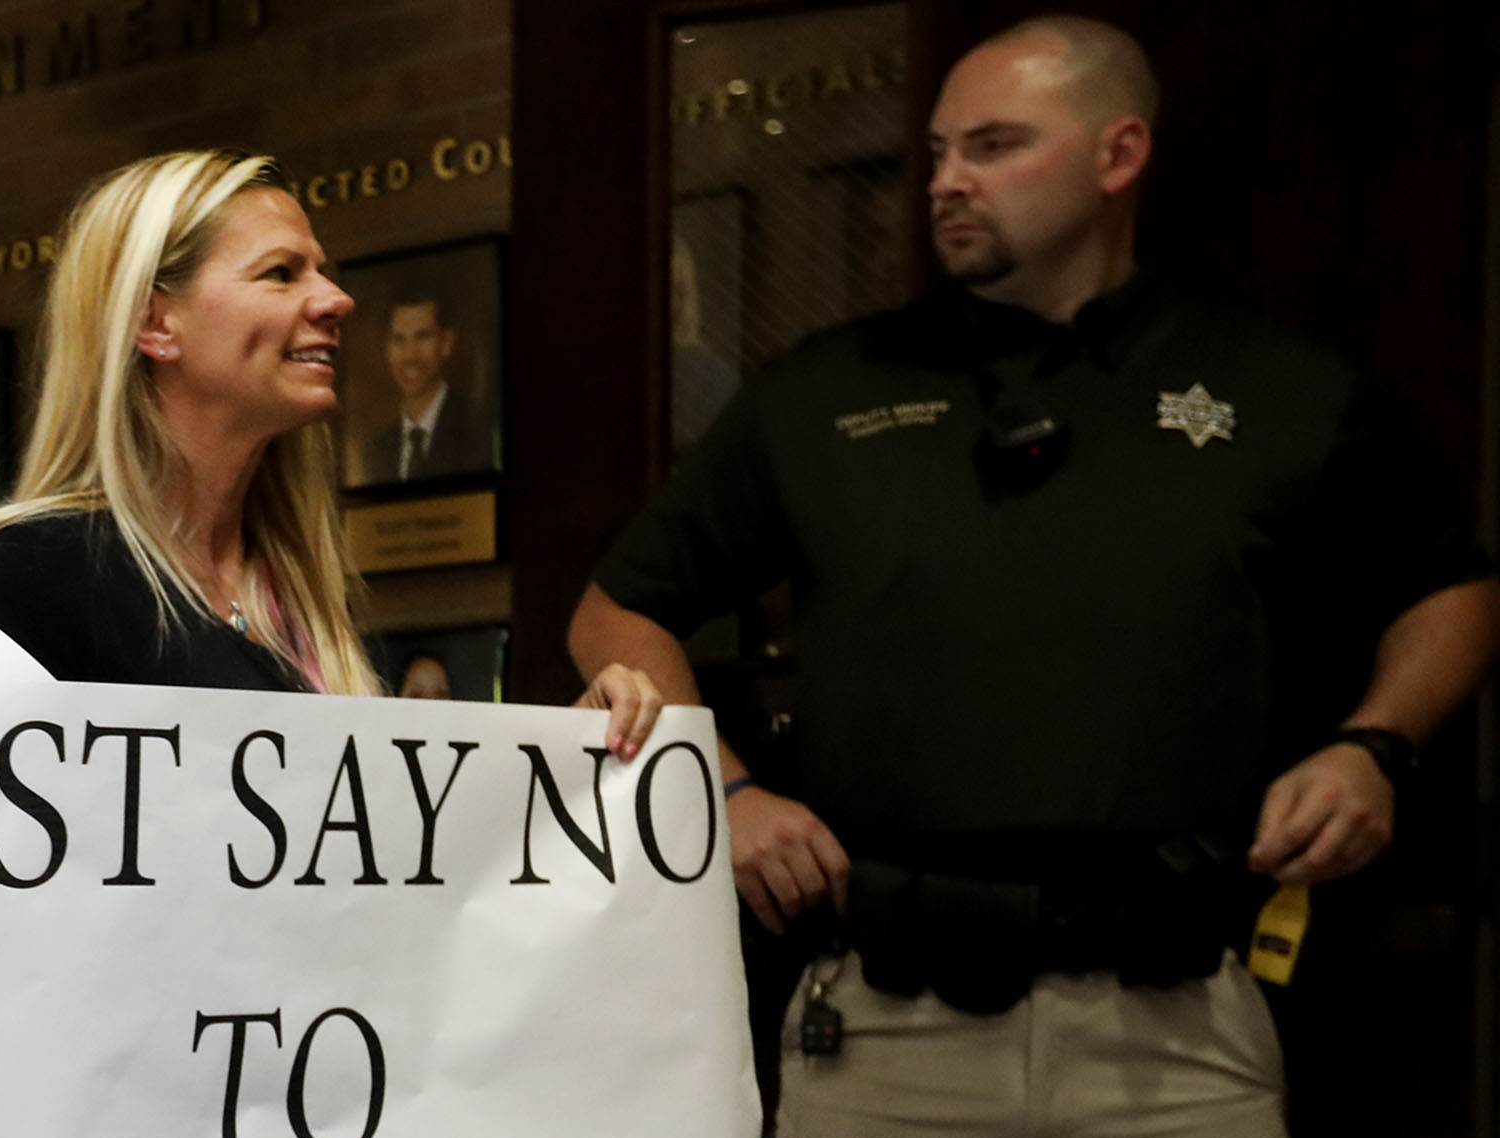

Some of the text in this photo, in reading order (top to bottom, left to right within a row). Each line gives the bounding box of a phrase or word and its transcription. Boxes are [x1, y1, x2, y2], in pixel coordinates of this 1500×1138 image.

[670, 50, 906, 128] FFICIALS
[288, 157, 412, 208] CTED
[227, 730, 479, 889] SAY
[509, 740, 718, 887] NO
